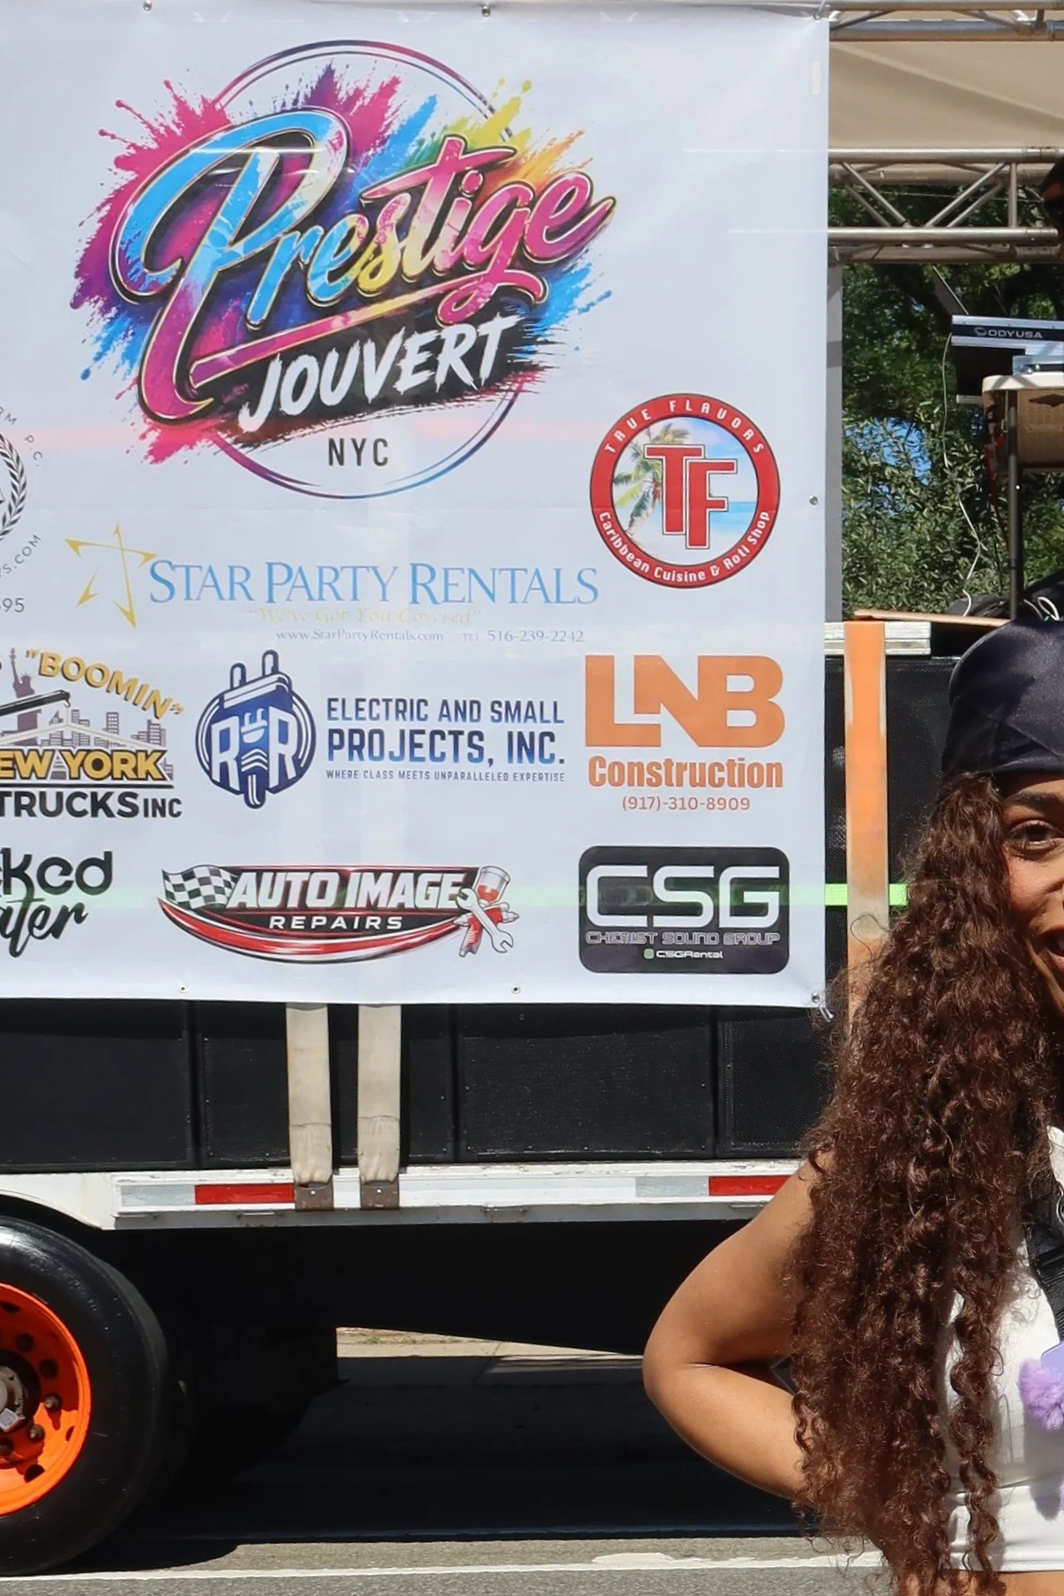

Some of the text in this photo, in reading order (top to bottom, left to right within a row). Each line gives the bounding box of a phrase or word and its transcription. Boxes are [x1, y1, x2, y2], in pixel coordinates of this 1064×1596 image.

[109, 107, 616, 425] Prestige
[238, 313, 522, 434] JOUVERT
[604, 408, 652, 454] TRUE
[328, 438, 389, 467] NYC
[643, 443, 739, 550] TF
[599, 511, 772, 583] Caribbean Cuisine & Roti Shop
[149, 559, 600, 605] STAR PARTY RENTALS
[275, 628, 444, 642] www.StarPartyRentals.com
[487, 629, 585, 643] 516-239-2242
[326, 697, 565, 724] ELECTRIC AND SMALL
[585, 655, 786, 748] LNB
[0, 749, 167, 781] EW YORK
[327, 728, 566, 767] PROJECTS, INC.
[326, 769, 566, 783] WHERE CLASS MEETS UNPARALLELED EXPERTISE
[588, 755, 784, 789] Construction
[143, 797, 183, 818] INC
[622, 795, 751, 811] (917)-310-8909
[226, 871, 466, 910] AUTO IMAGE
[586, 865, 780, 929] CSG
[269, 915, 403, 930] REPAIRS
[585, 931, 781, 946] CHEMIST SOUND GROUP
